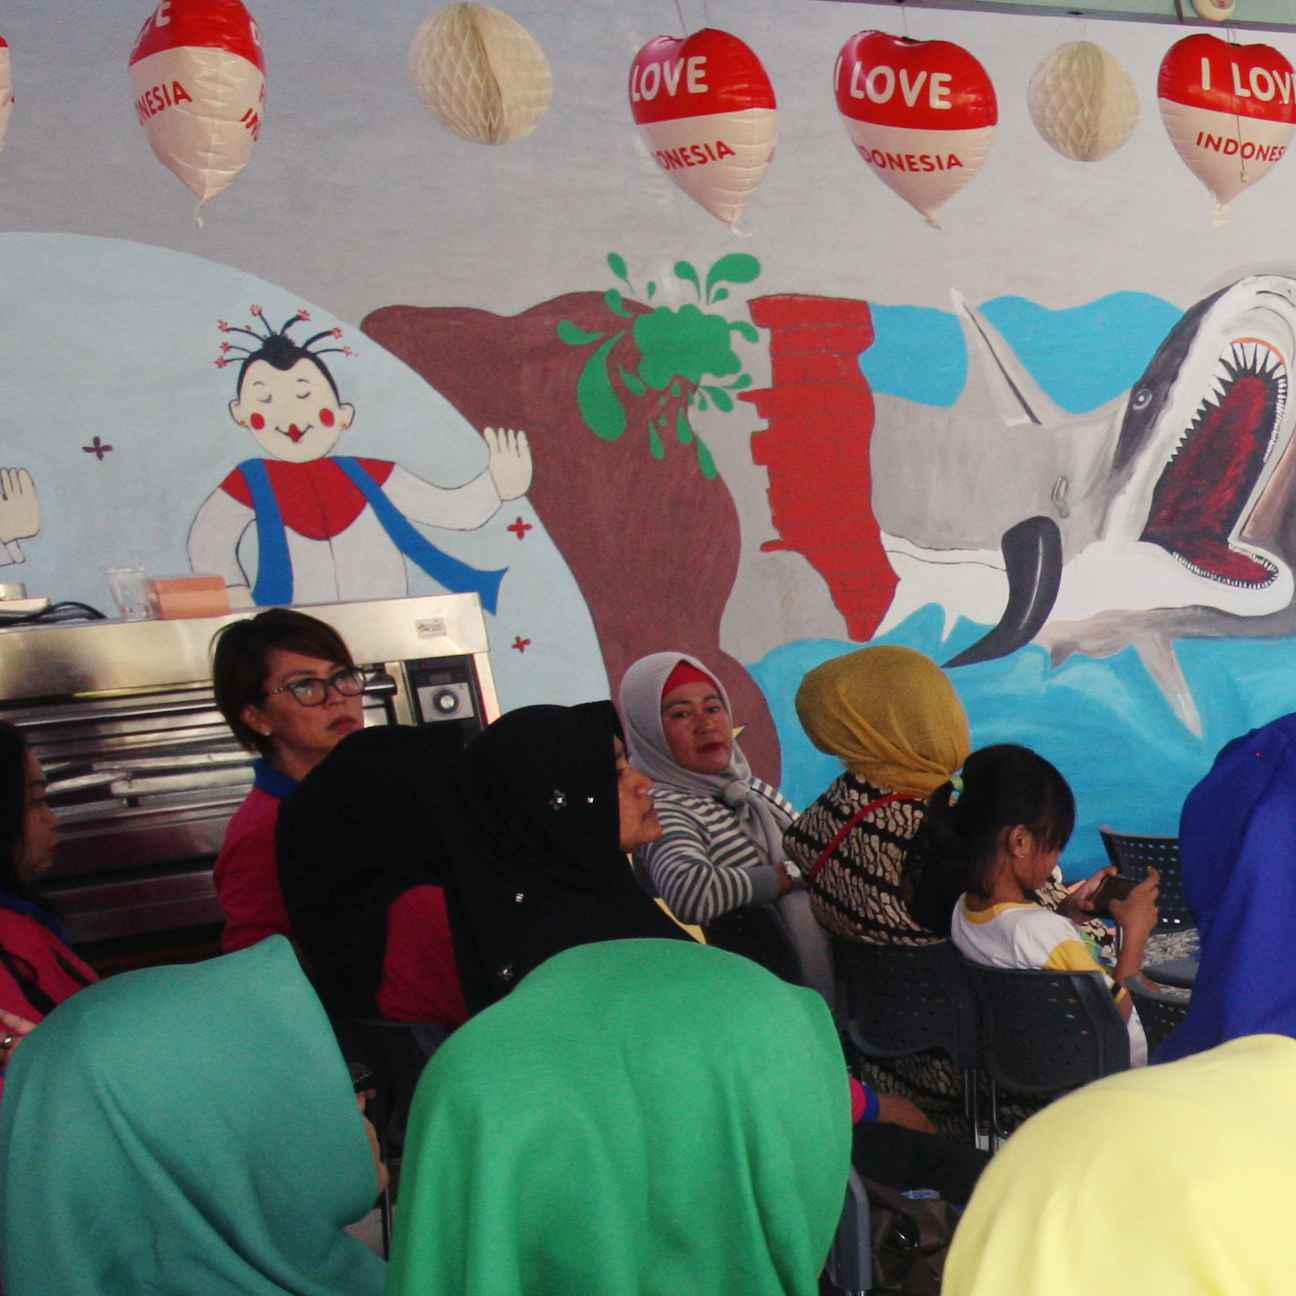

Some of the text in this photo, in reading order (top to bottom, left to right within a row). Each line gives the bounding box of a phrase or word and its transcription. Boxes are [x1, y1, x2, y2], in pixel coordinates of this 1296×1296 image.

[632, 56, 709, 102] LOVE
[850, 61, 953, 109] LOVE
[1201, 57, 1211, 90] I
